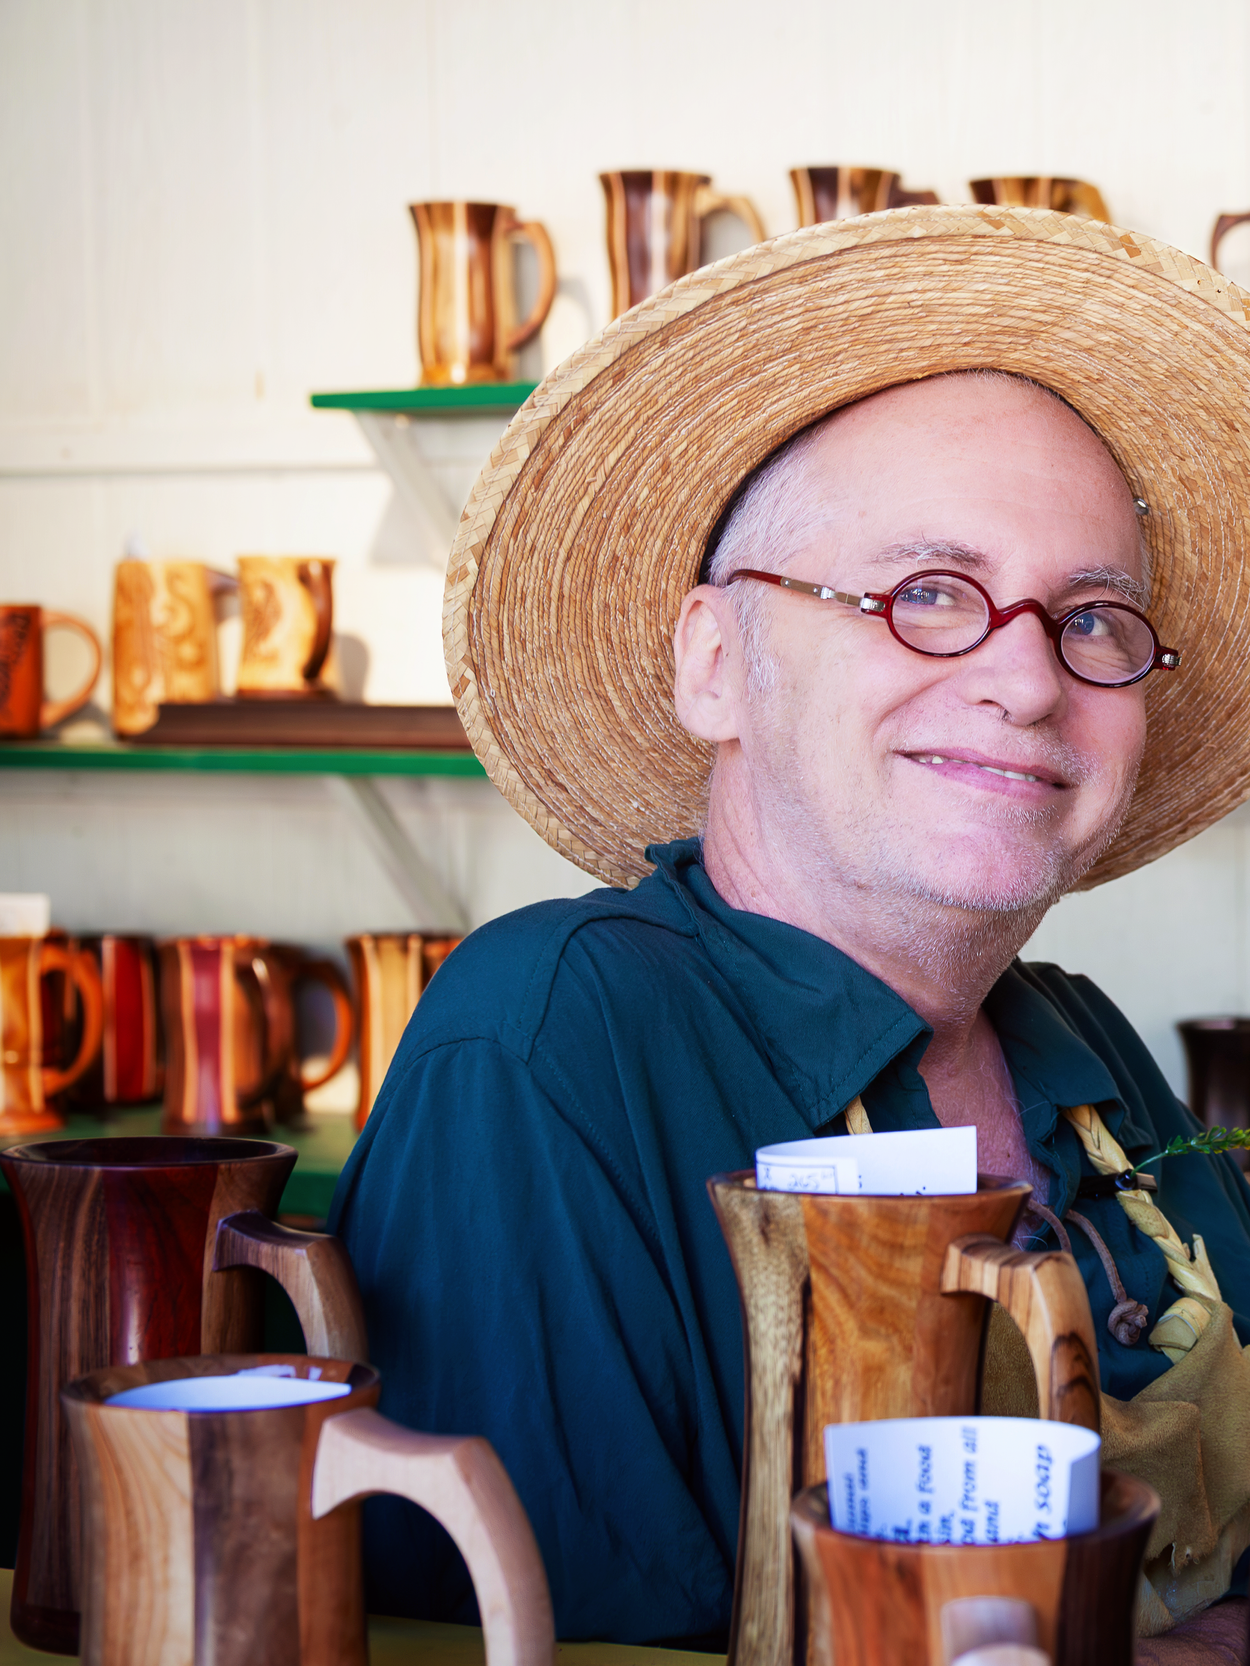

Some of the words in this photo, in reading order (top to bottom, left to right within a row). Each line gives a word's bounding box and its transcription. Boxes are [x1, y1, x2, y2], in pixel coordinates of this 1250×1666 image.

[962, 1426, 976, 1453] all
[917, 1444, 934, 1494] food
[960, 1460, 978, 1512] from
[1035, 1444, 1052, 1515] soap
[918, 1500, 931, 1515] a
[985, 1500, 999, 1543] and
